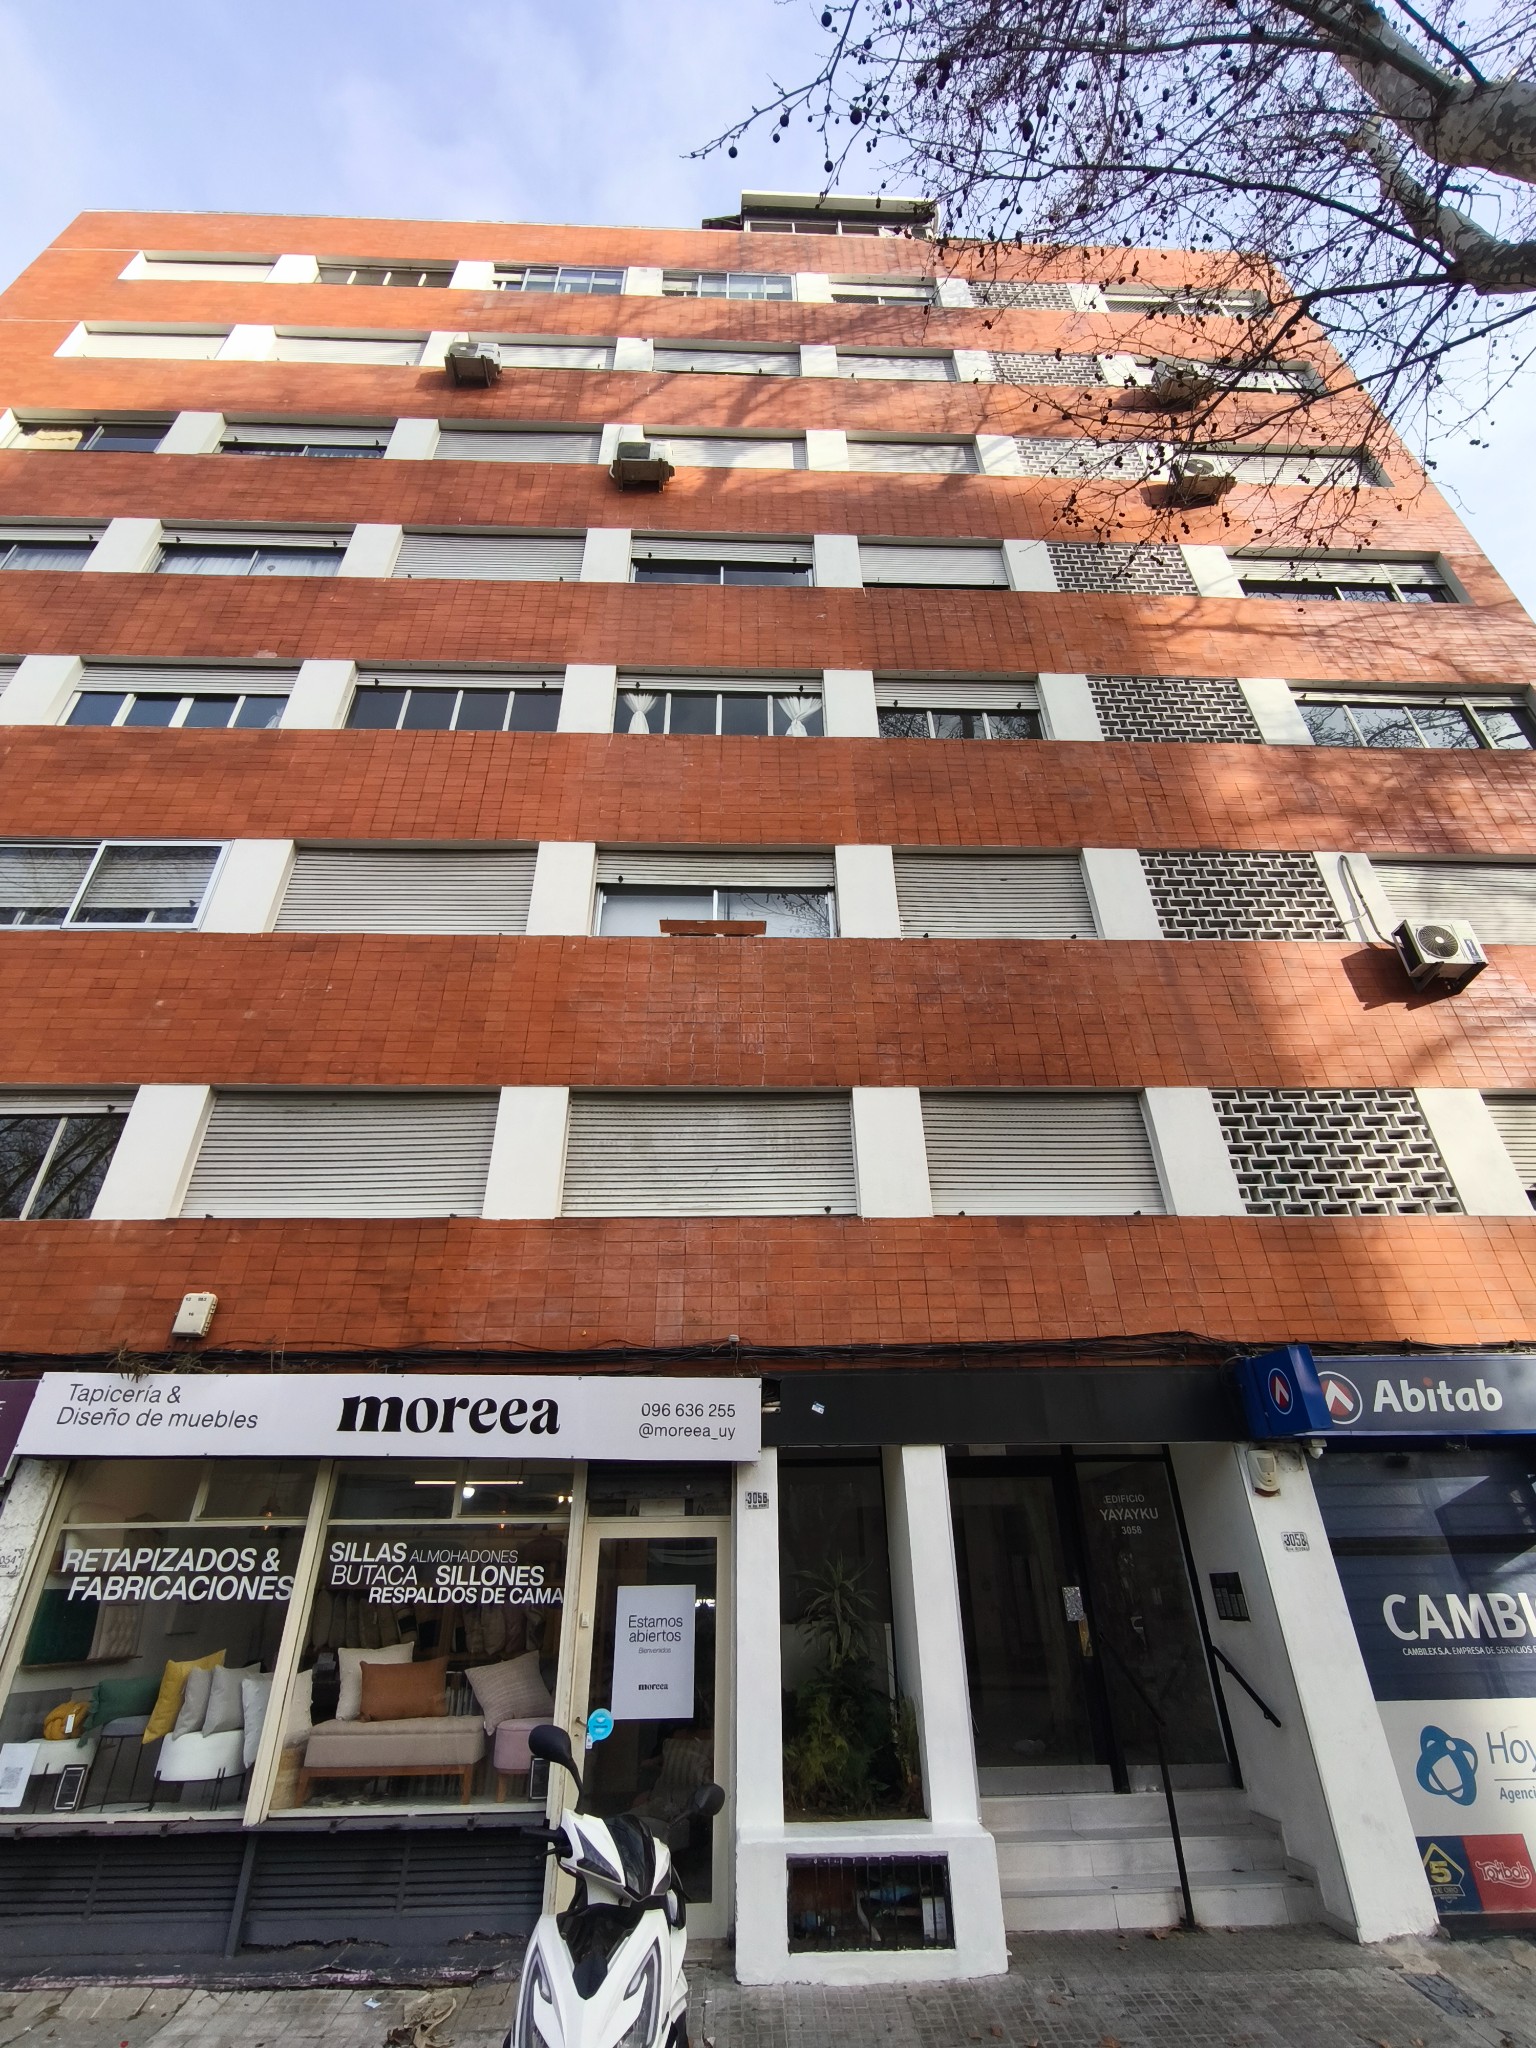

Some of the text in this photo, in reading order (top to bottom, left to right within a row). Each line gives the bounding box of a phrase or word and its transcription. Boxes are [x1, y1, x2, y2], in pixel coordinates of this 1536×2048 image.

[69, 1383, 181, 1406] Tapicería &
[1373, 1377, 1503, 1412] Abitab
[56, 1406, 258, 1429] Diseño de muebles
[336, 1395, 560, 1435] moreea
[641, 1402, 736, 1418] 096 636 255
[638, 1422, 736, 1441] @moreea_uy
[747, 1491, 768, 1505] 3056
[1104, 1494, 1145, 1504] EDIFICIO
[1099, 1507, 1159, 1521] YAYAYKU
[1121, 1525, 1143, 1535] 3058
[1283, 1533, 1307, 1547] 3058
[61, 1547, 280, 1573] RETAPIZADOS &
[329, 1542, 518, 1563] SILLAS ALMOHADONES
[331, 1565, 545, 1586] BUTACA SILLONES
[67, 1575, 294, 1601] FABRICACIONES
[369, 1587, 564, 1604] RESPALDOS DE CAMA
[628, 1614, 683, 1628] Estamos
[1383, 1592, 1536, 1641] CAMBI
[629, 1629, 681, 1643] abiertos
[1402, 1647, 1438, 1656] CAMBILEX
[1452, 1646, 1485, 1655] EMPRESA
[1485, 1646, 1496, 1654] DE
[1496, 1646, 1533, 1654] SERVICIOS
[638, 1682, 669, 1691] moreea
[1429, 1860, 1452, 1884] 5
